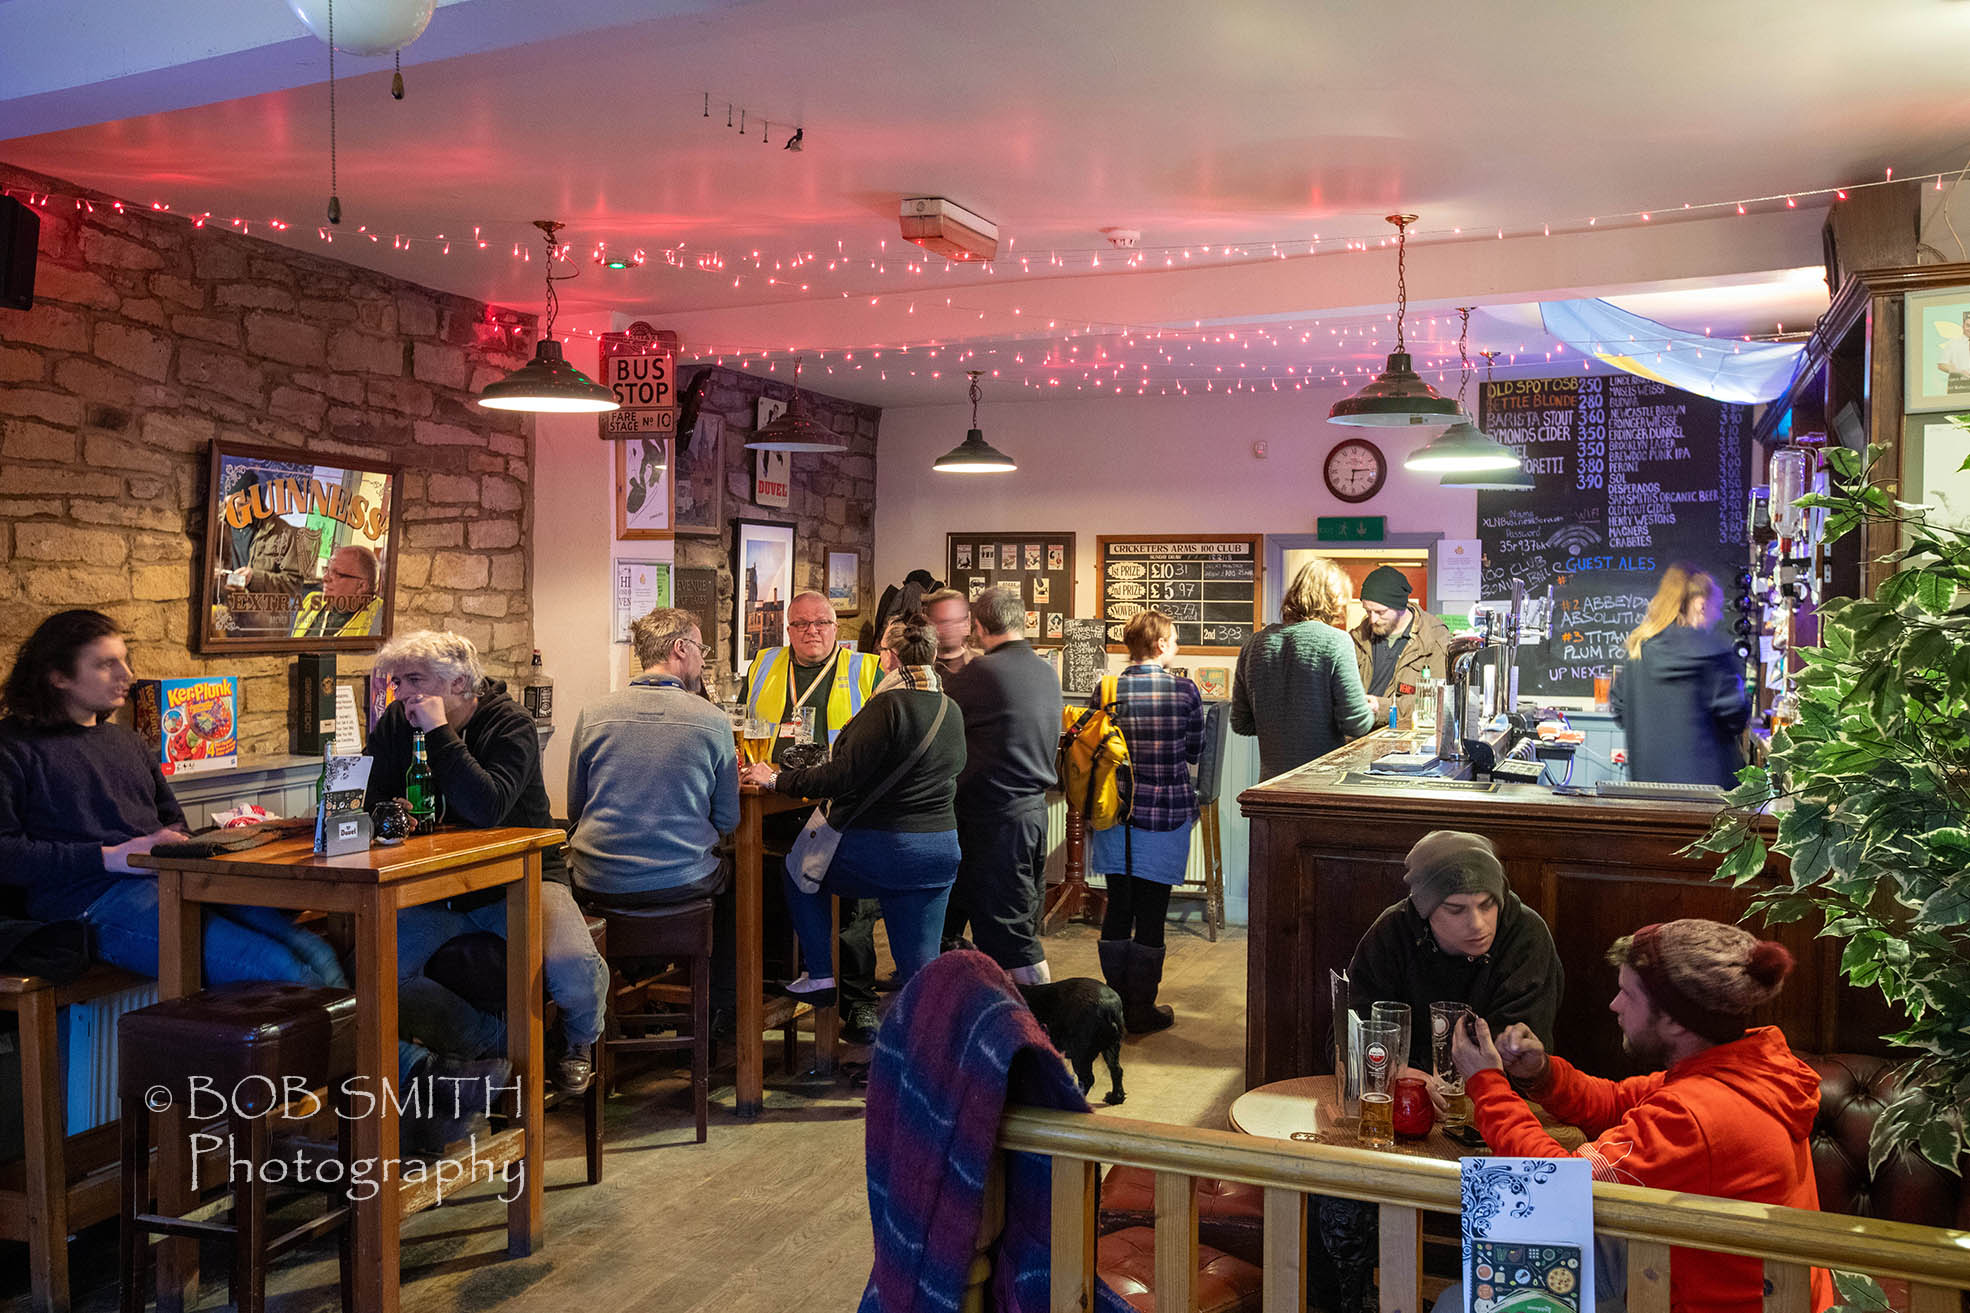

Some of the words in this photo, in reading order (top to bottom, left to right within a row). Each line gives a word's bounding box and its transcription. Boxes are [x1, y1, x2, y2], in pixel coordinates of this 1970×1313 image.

[617, 358, 664, 380] BUS
[612, 382, 668, 403] STOP
[1489, 381, 1513, 398] OLD
[1516, 379, 1552, 393] SPOT
[1553, 376, 1578, 391] OSB
[1533, 394, 1577, 407] BLONDE
[611, 411, 636, 422] FARE
[1655, 405, 1686, 416] BROWN
[657, 413, 671, 428] 10
[1487, 411, 1540, 428] BARISTA
[1543, 410, 1574, 426] STOUT
[610, 422, 638, 431] STAGE
[1608, 428, 1648, 440] ERDINGER
[1649, 426, 1686, 439] DUNKEL
[1487, 427, 1537, 444] SYMONDS
[1537, 426, 1571, 442] CIDER
[1608, 439, 1648, 451] BROOKLYN
[1649, 448, 1673, 460] PUNK
[1674, 447, 1692, 459] IPA
[1609, 461, 1639, 473] PERONI
[1609, 473, 1626, 484] SOL
[758, 479, 788, 497] DUVEL
[1608, 482, 1660, 494] DESPERADOS
[1698, 489, 1719, 502] BEER
[225, 477, 388, 541] GUINNESS
[1608, 504, 1623, 516] OLD
[1646, 503, 1672, 514] CIDER
[1608, 515, 1633, 527] HENRY
[1634, 513, 1677, 526] WESTONS
[1608, 525, 1649, 537] MAGNERS
[1113, 544, 1169, 553] CRICKETERS
[1171, 544, 1198, 553] ARMS
[1200, 543, 1215, 553] 100
[1216, 543, 1242, 553] CLUB
[1510, 555, 1547, 576] CLUB
[1566, 555, 1614, 571] GUEST
[1619, 556, 1656, 571] ALES
[1120, 565, 1141, 577] PRIZE
[1151, 563, 1175, 579] £10
[1175, 564, 1188, 576] 31
[1122, 584, 1141, 595] PRIZE
[1164, 581, 1175, 600] 5
[1179, 582, 1195, 598] 97
[230, 592, 305, 613] EXTRA
[310, 593, 373, 613] STOUT
[1203, 628, 1216, 640] 2nd
[1218, 625, 1243, 641] 303
[1562, 631, 1584, 643] #3
[1563, 645, 1603, 660] PLUM
[1549, 667, 1568, 681] UP
[1571, 664, 1607, 680] NEXT
[207, 743, 215, 757] 4
